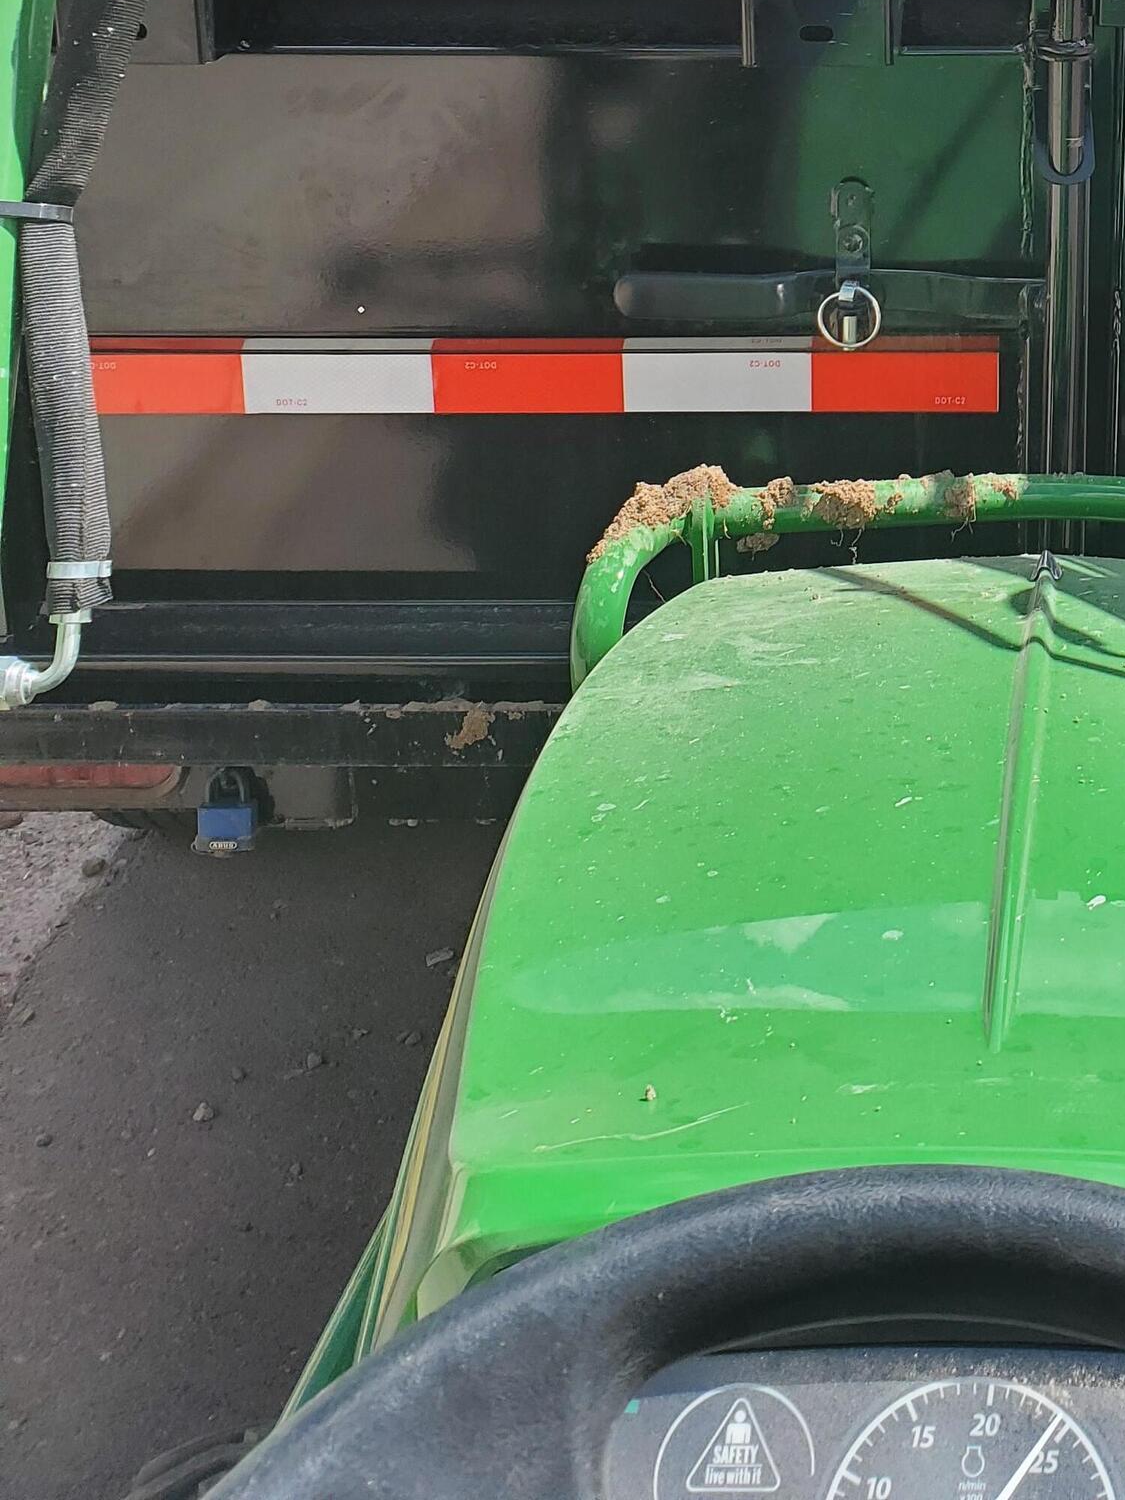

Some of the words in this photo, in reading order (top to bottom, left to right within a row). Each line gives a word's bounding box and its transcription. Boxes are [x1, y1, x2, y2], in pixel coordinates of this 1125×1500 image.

[911, 1425, 936, 1449] 15
[969, 1413, 1001, 1437] 20
[713, 1444, 759, 1464] SAFETY
[1028, 1450, 1059, 1474] 25
[704, 1466, 725, 1485] live
[726, 1466, 751, 1485] with
[751, 1466, 763, 1485] it
[866, 1476, 892, 1500] 10
